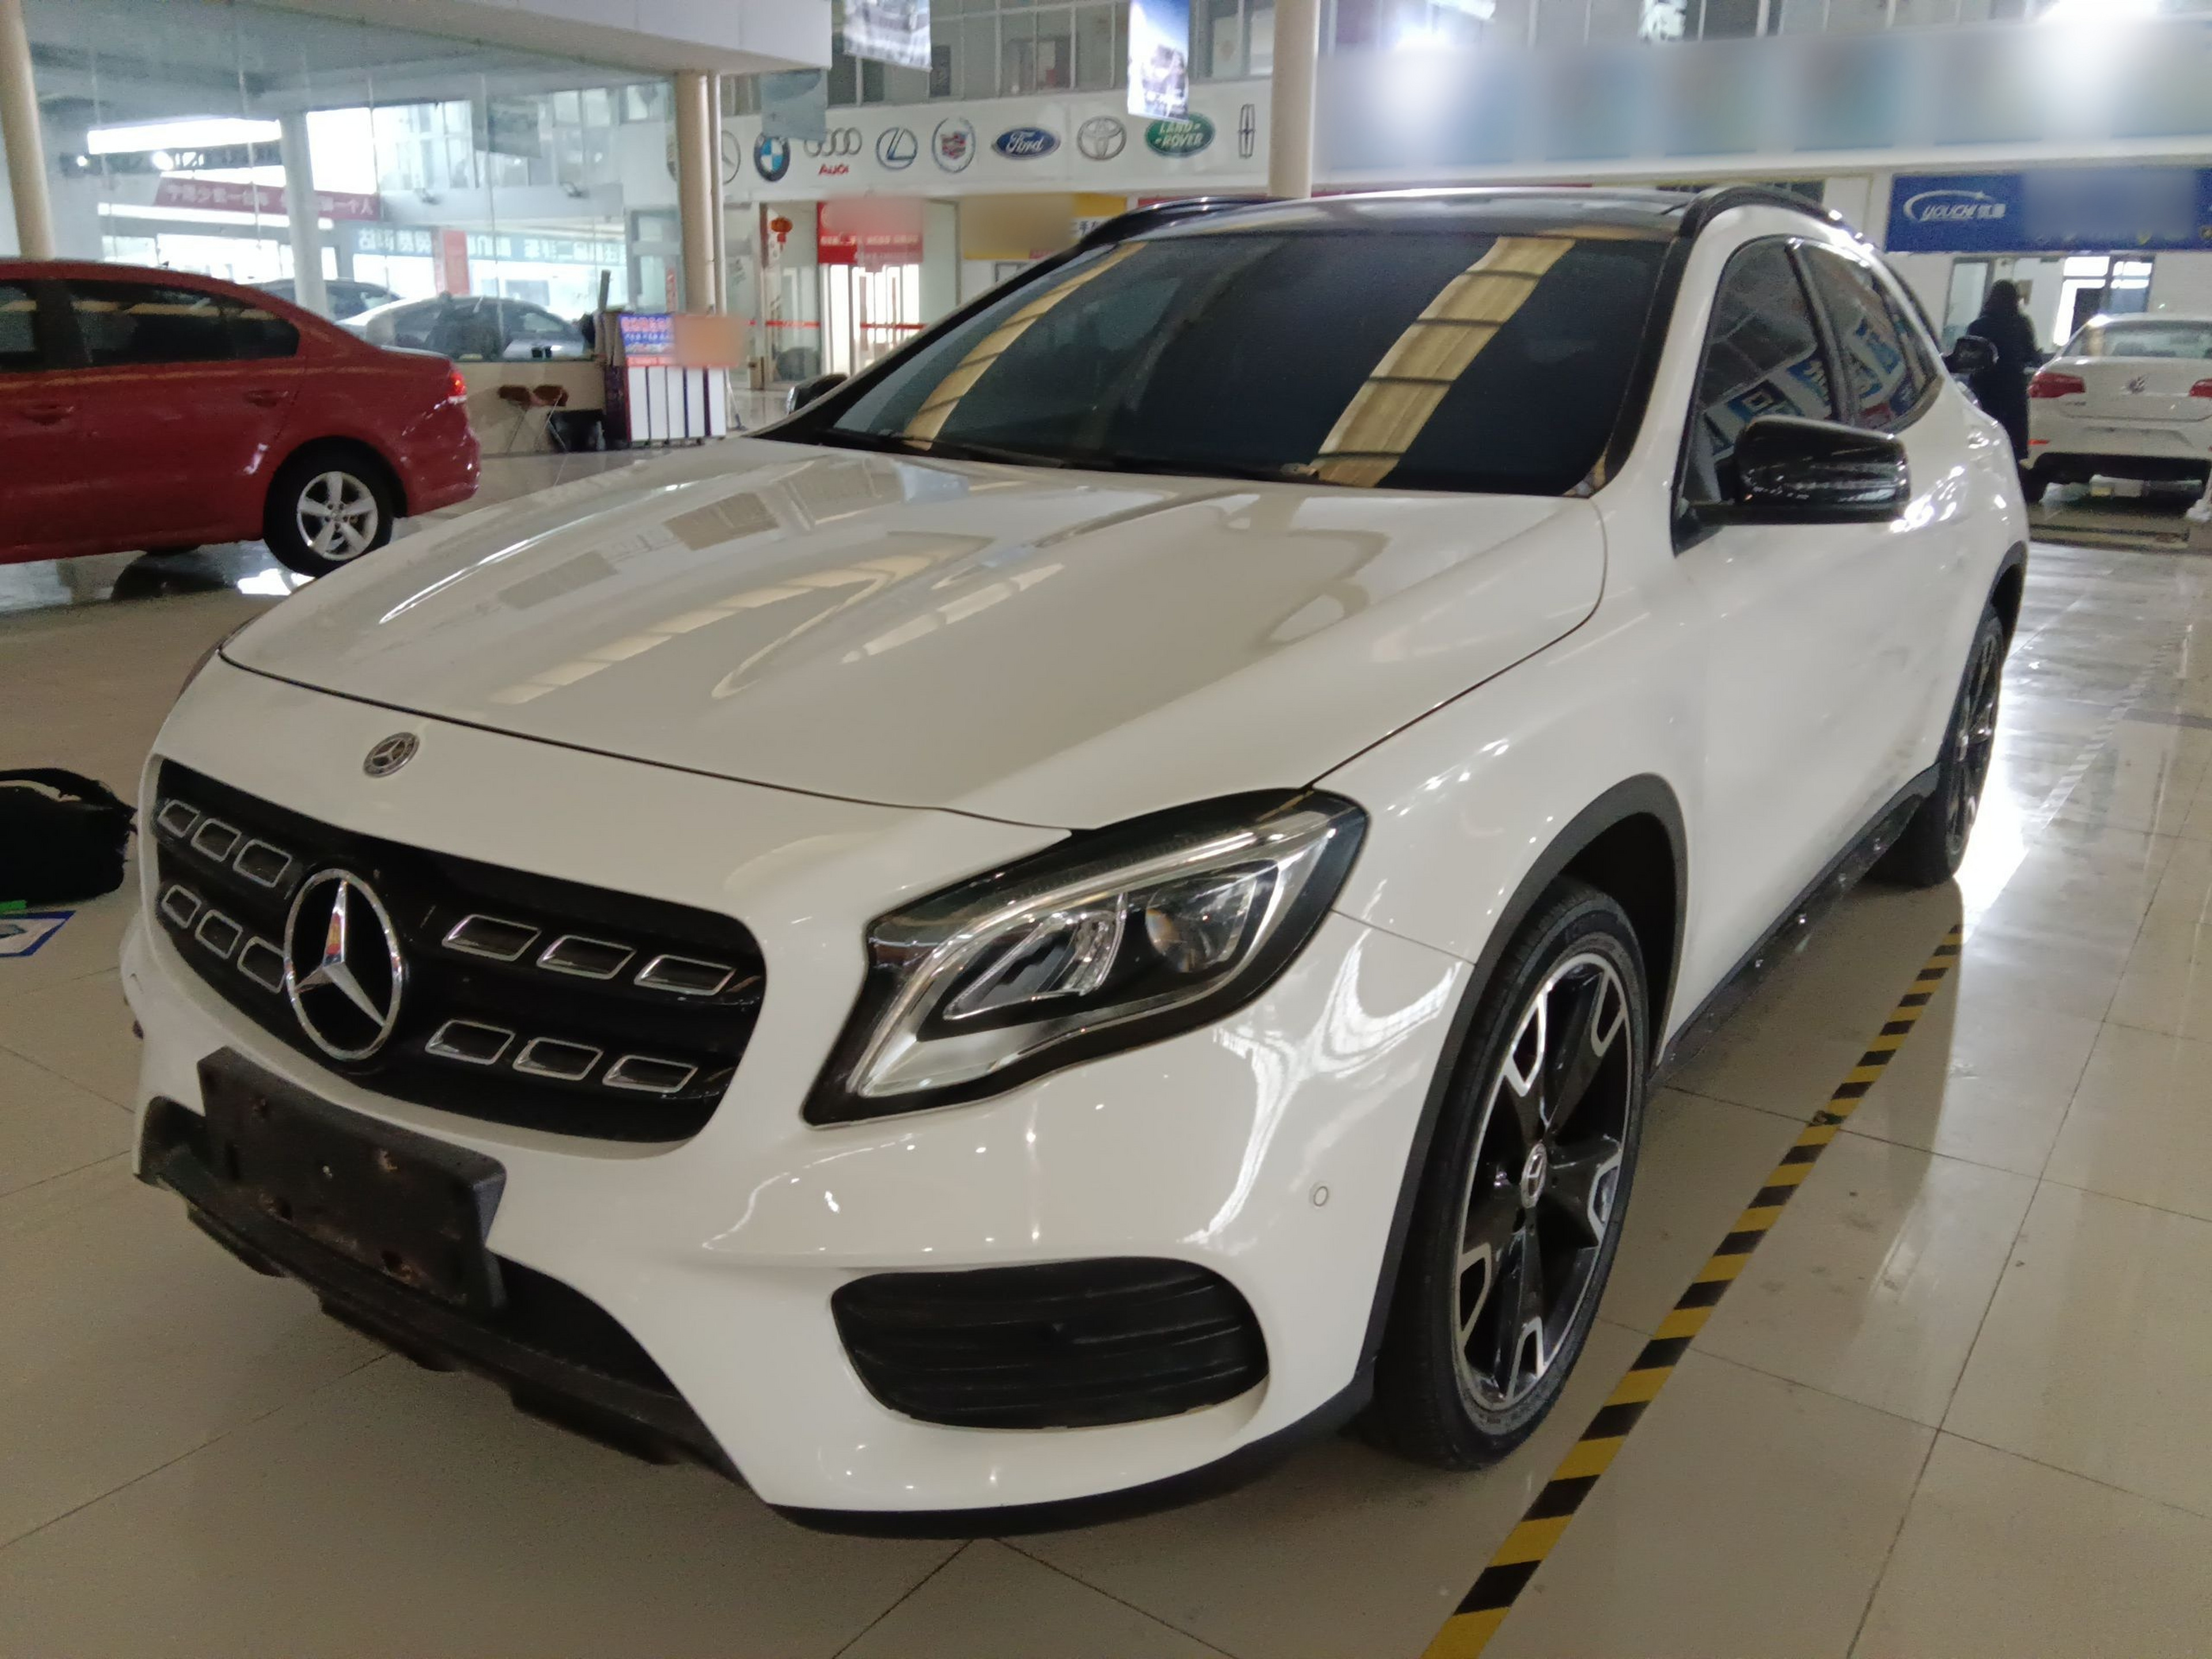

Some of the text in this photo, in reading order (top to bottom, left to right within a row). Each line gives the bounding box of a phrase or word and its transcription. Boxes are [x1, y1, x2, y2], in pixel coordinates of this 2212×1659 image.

[1159, 120, 1193, 135] LAND
[1005, 131, 1045, 153] Ford
[1161, 132, 1204, 149] ROVER
[818, 163, 850, 175] AUDI
